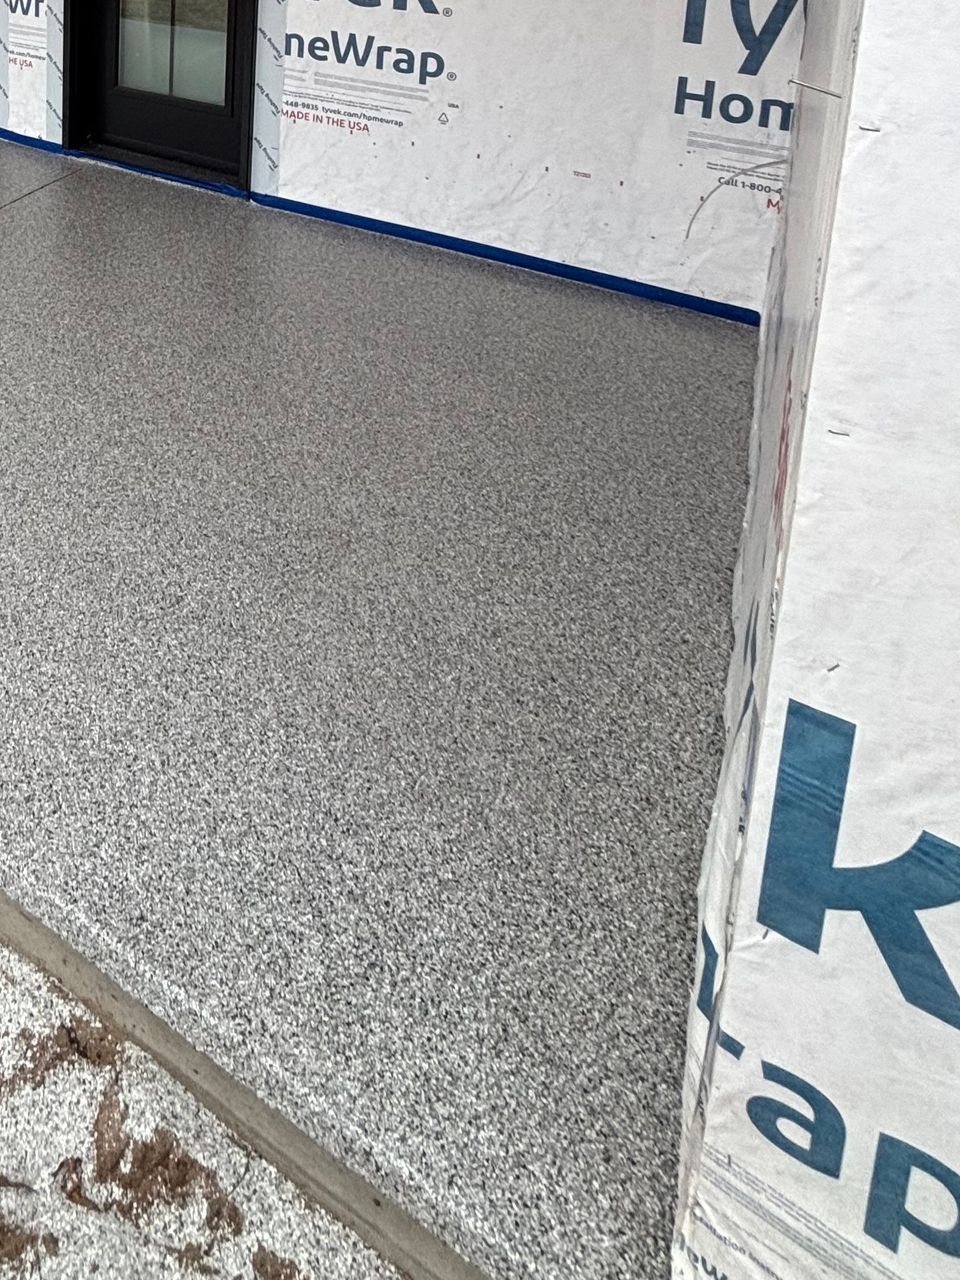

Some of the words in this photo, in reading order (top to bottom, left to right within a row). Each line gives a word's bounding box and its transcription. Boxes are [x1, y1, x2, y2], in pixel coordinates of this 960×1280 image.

[19, 59, 33, 68] USA
[281, 110, 310, 122] MADE
[312, 114, 324, 124] IN
[326, 116, 346, 128] THE
[349, 119, 370, 132] USA
[322, 106, 404, 127] tyvek.com/homewrap
[718, 177, 738, 188] Call
